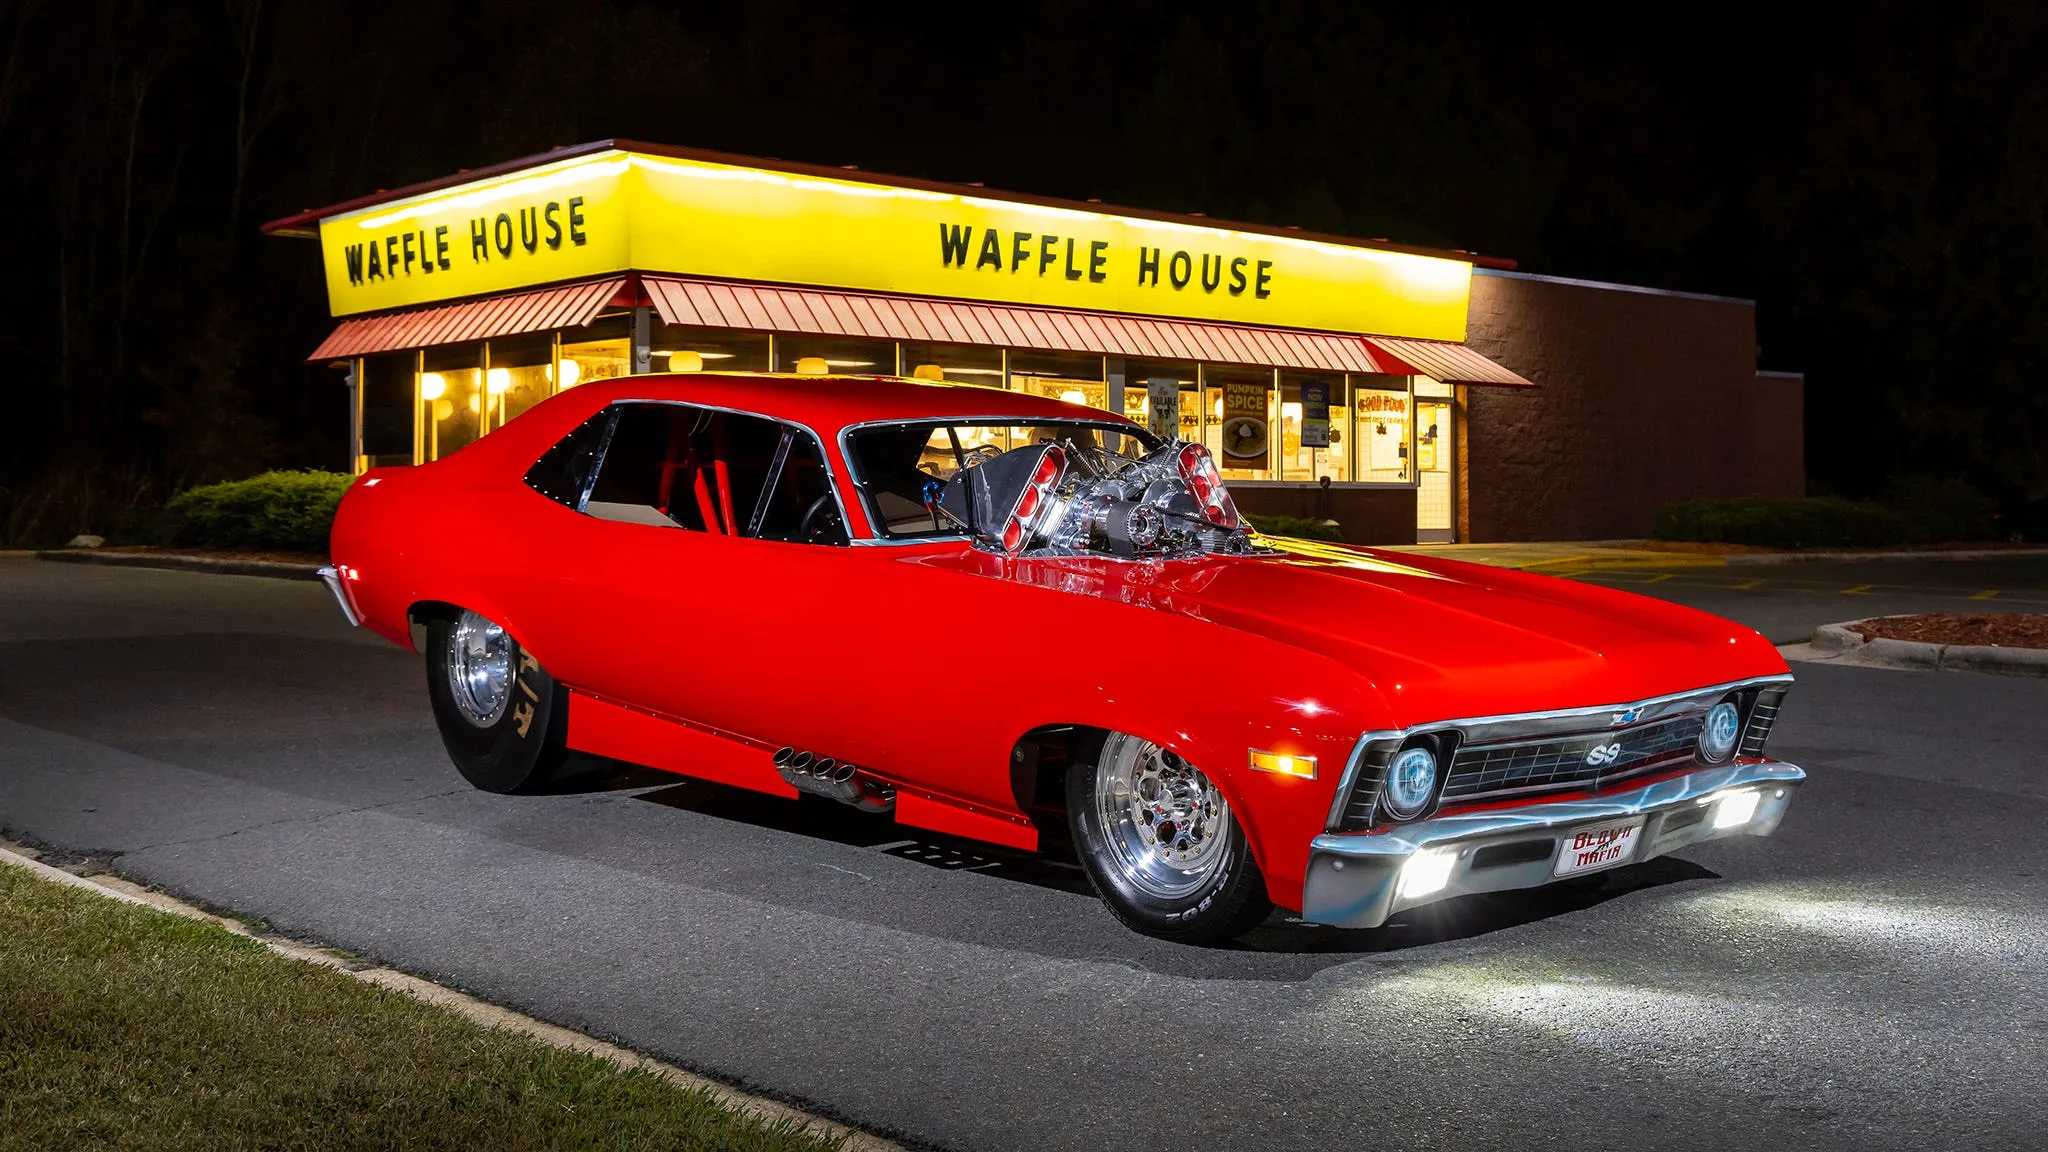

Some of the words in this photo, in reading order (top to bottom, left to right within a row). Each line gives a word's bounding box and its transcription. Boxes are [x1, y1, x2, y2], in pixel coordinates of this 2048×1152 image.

[345, 226, 450, 285] WAFFLE
[471, 196, 586, 262] HOUSE
[939, 223, 1109, 282] WAFFLE
[1138, 246, 1273, 298] HOUSE
[1227, 383, 1264, 395] PUMPKIN
[1227, 395, 1264, 410] SPICE
[1586, 743, 1620, 766] SS
[1576, 845, 1622, 867] MAFIA
